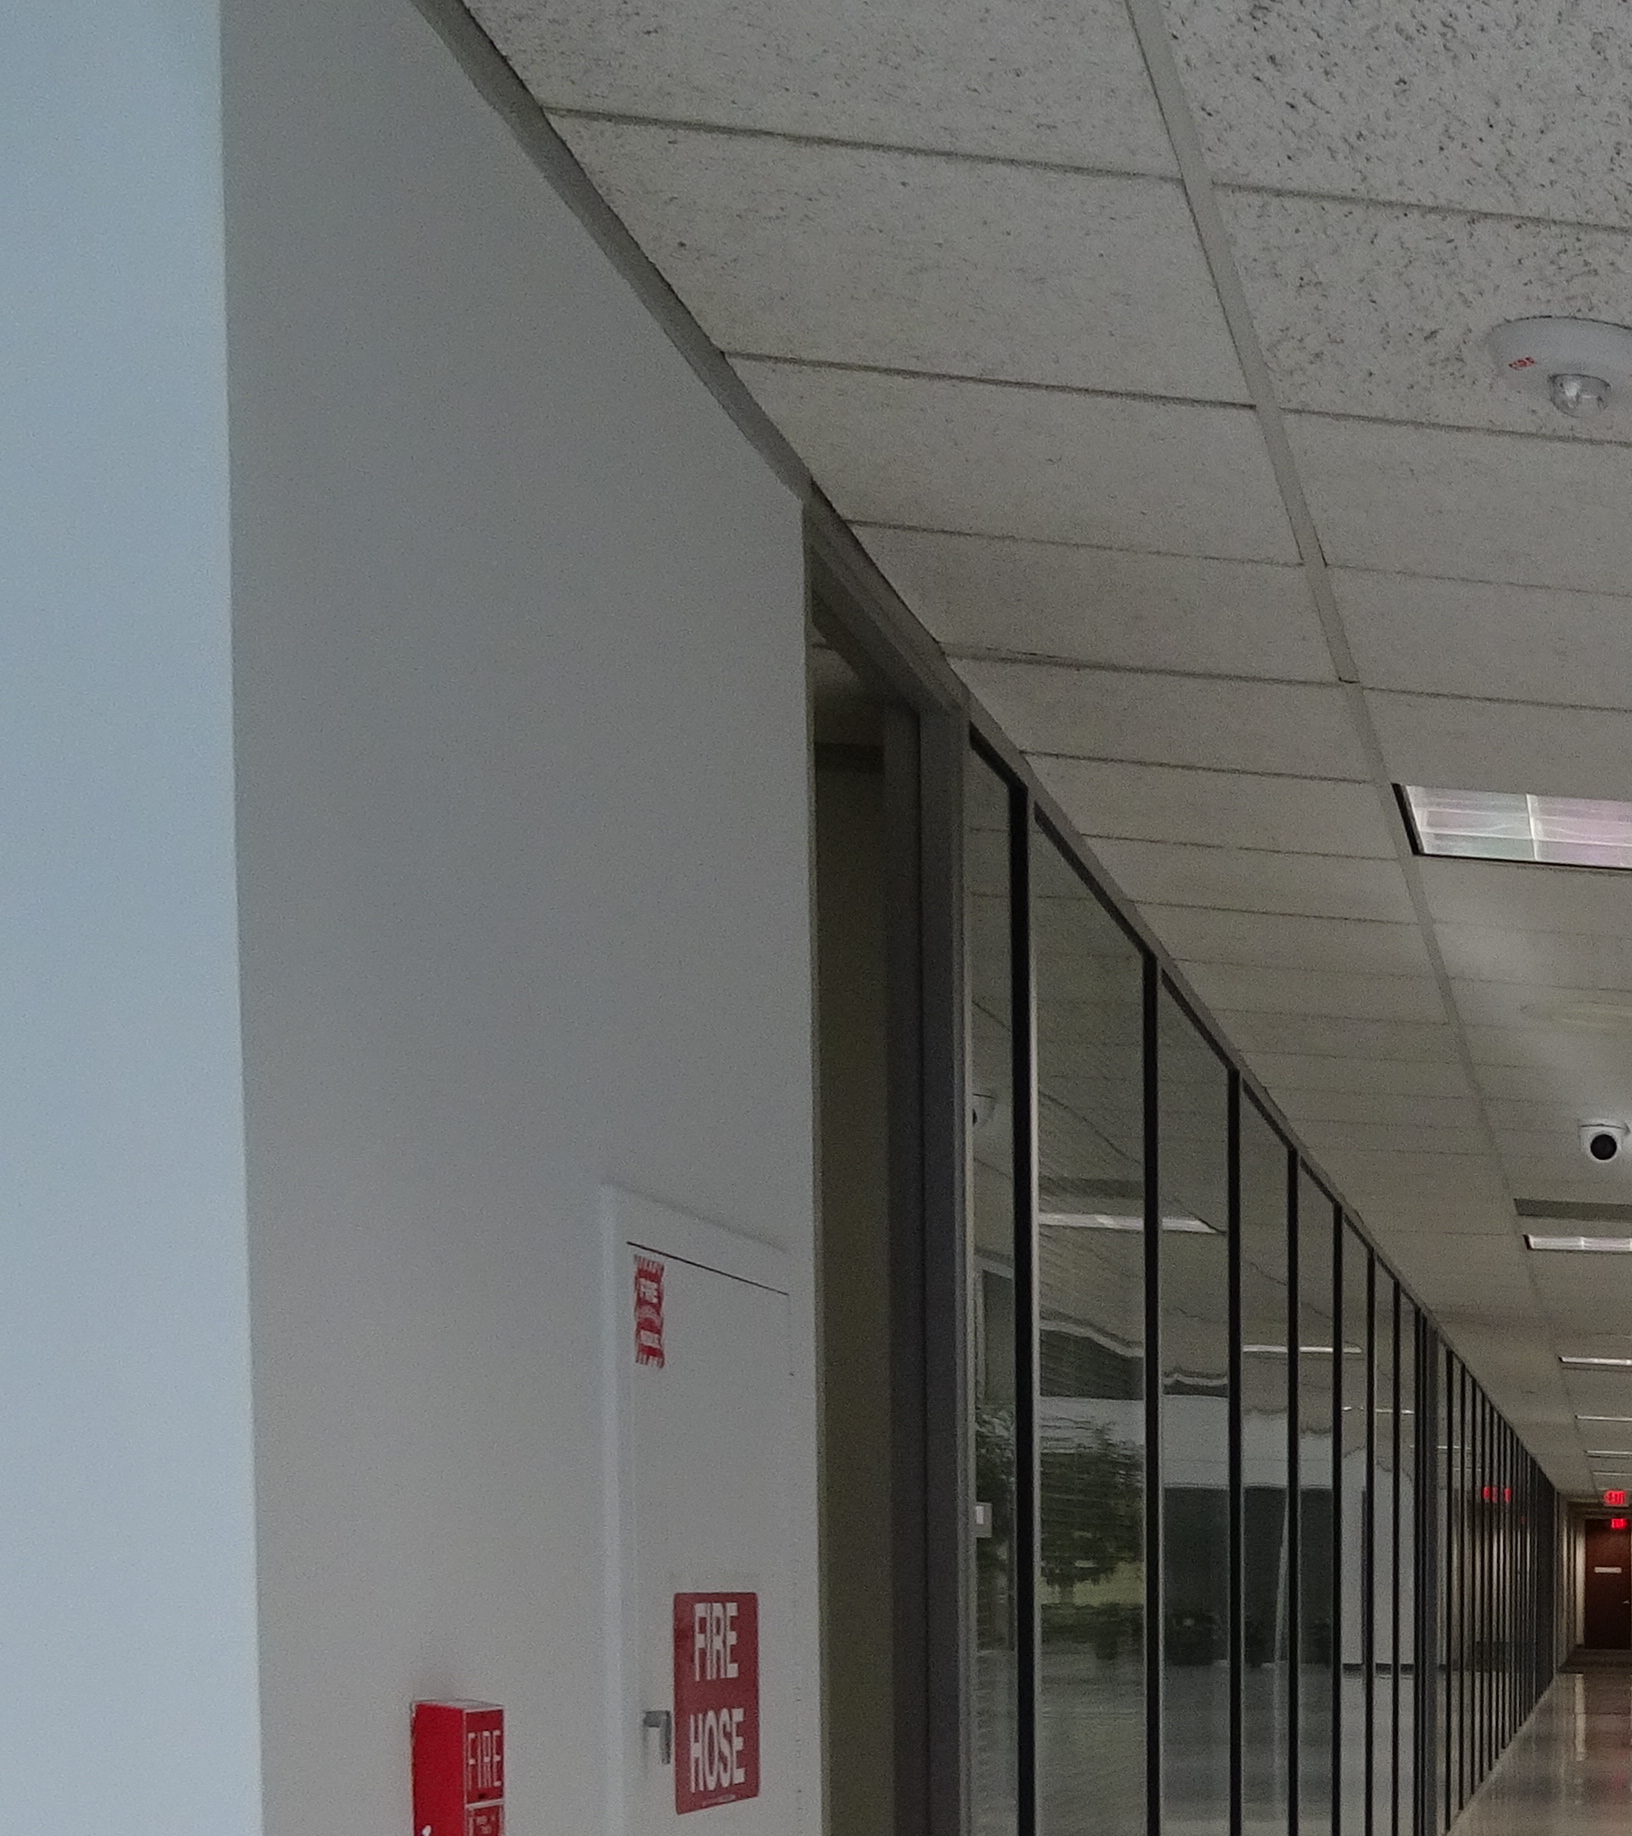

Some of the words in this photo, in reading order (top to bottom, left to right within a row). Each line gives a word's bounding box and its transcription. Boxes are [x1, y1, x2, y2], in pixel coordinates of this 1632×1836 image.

[694, 1602, 739, 1681] FIRE
[467, 1730, 502, 1790] FIRE
[690, 1707, 745, 1793] HOSE
